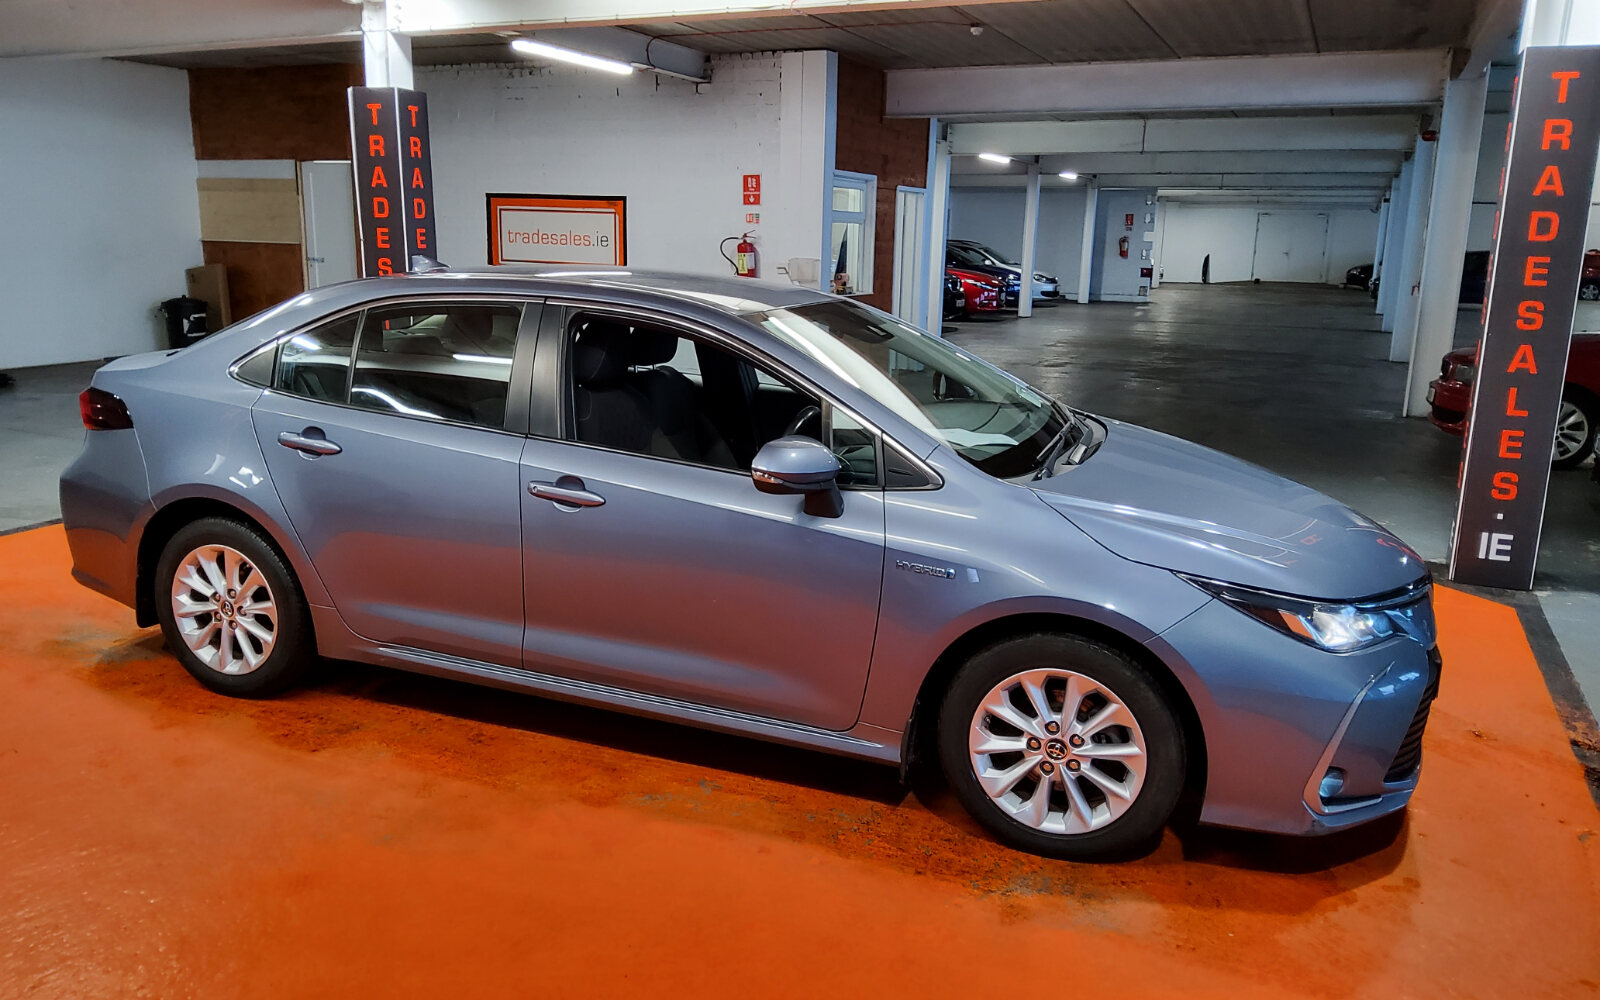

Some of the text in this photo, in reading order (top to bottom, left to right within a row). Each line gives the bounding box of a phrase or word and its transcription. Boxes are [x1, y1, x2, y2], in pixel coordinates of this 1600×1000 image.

[407, 105, 428, 249] TRADE
[507, 228, 609, 248] tradesales.ie
[895, 559, 947, 579] HYBRID
